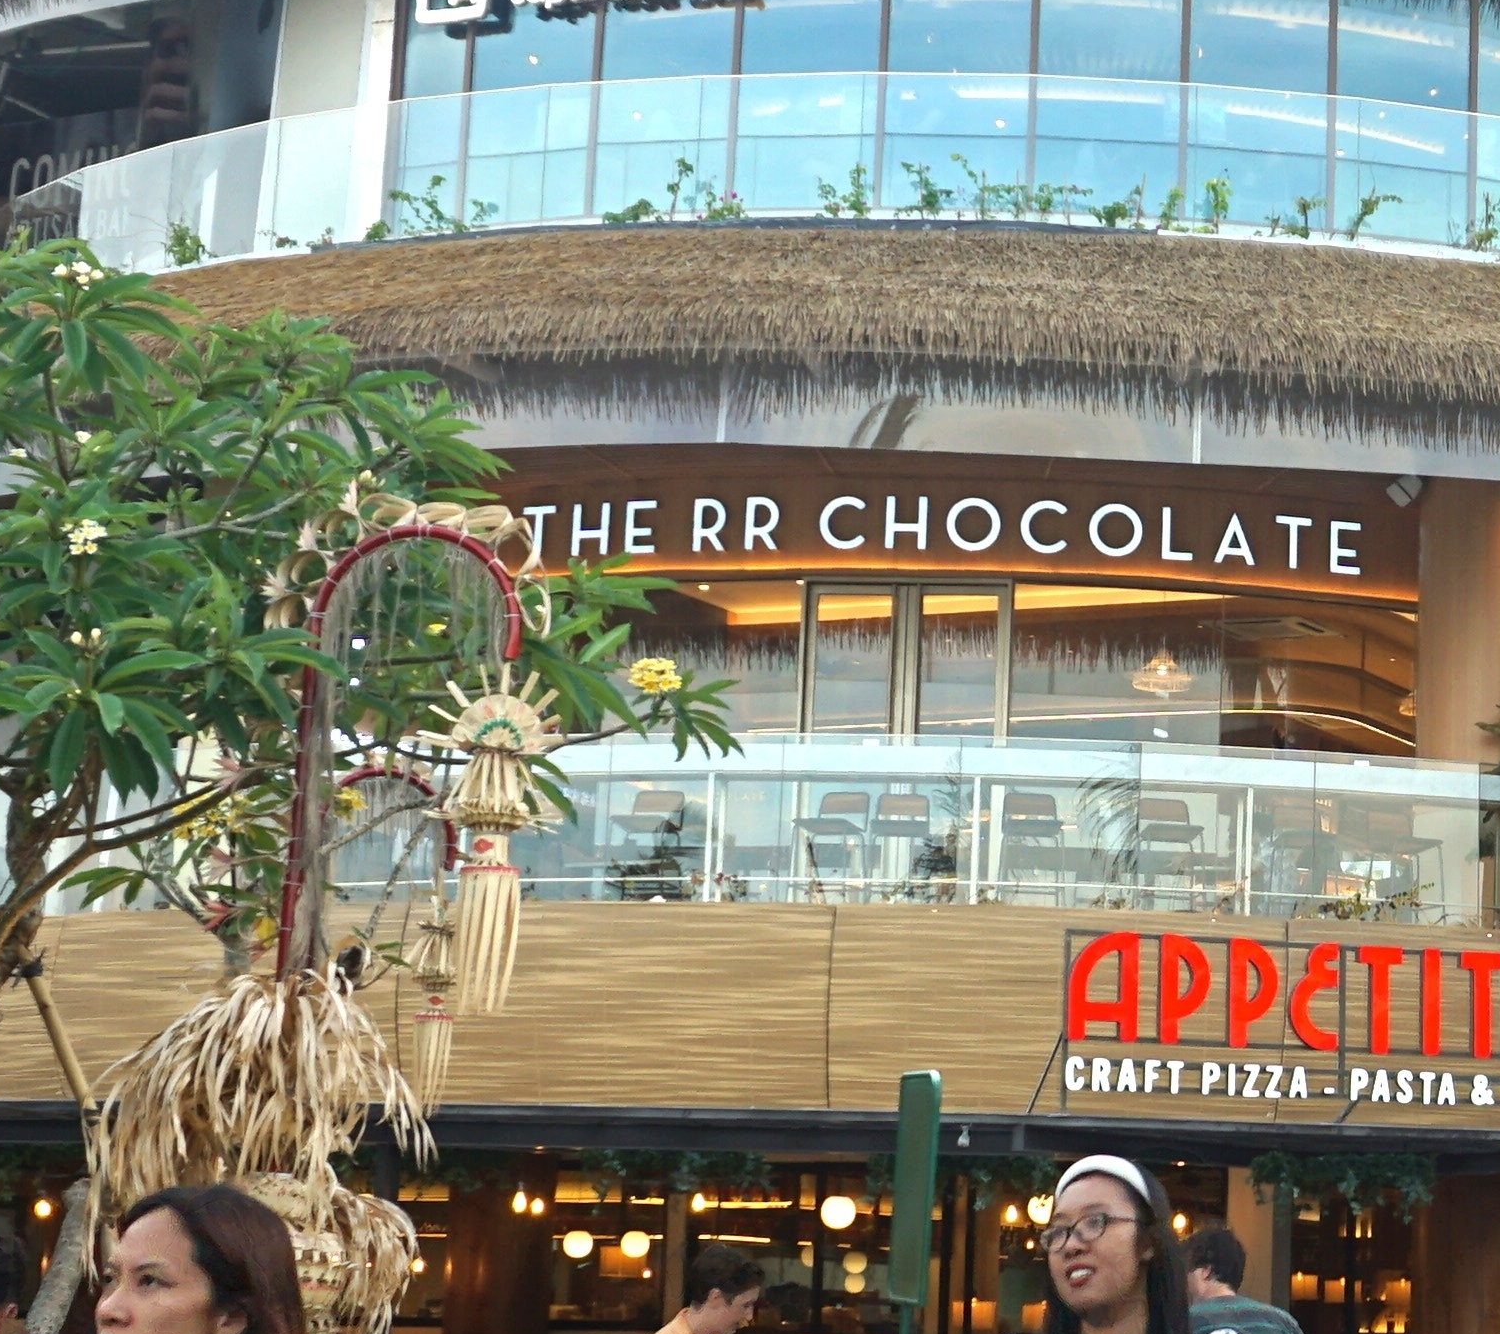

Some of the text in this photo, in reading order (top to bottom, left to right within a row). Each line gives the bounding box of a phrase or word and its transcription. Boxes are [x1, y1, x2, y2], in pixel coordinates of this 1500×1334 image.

[522, 495, 1362, 575] THE RR CHOCOLATE
[1064, 1055, 1185, 1095] CRAFT
[1201, 1061, 1309, 1100] PIZZA
[1350, 1067, 1457, 1107] PASTA
[1470, 1074, 1495, 1106] &
